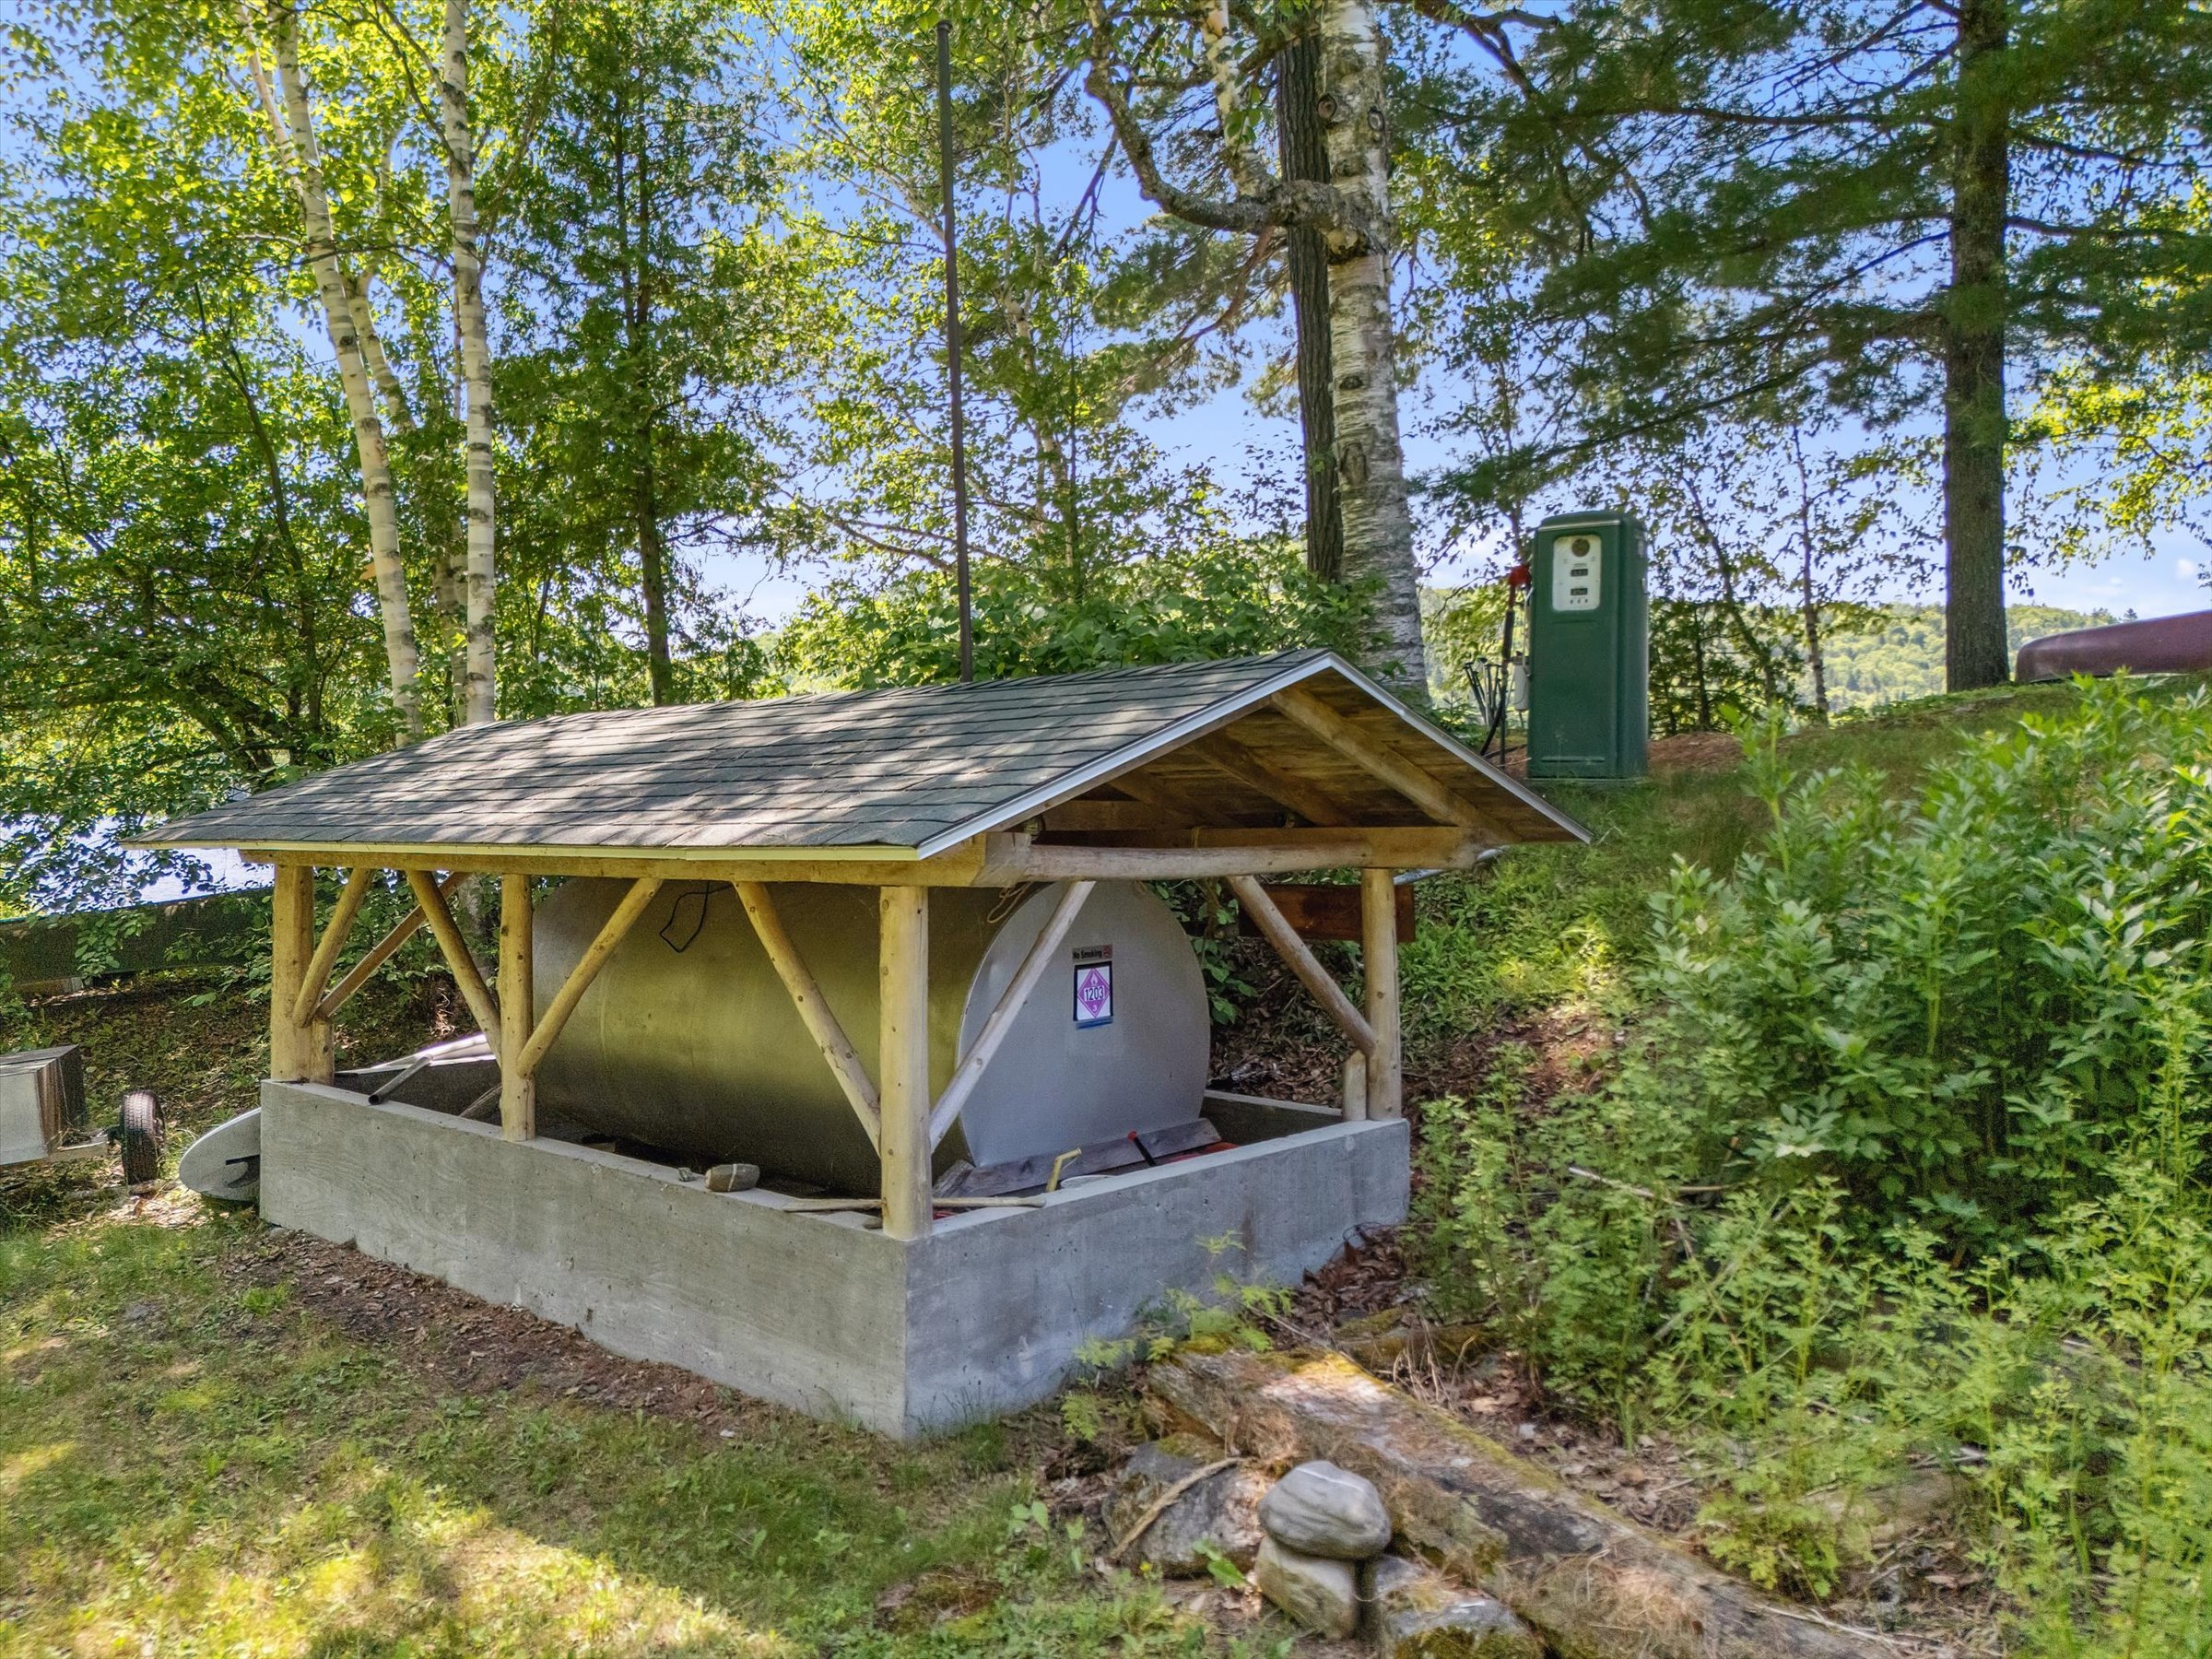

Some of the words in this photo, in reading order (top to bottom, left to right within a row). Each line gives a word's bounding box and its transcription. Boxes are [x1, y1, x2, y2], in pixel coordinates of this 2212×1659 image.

[1073, 950, 1080, 959] No
[1081, 949, 1102, 959] Smoking
[1085, 986, 1104, 1001] 1203
